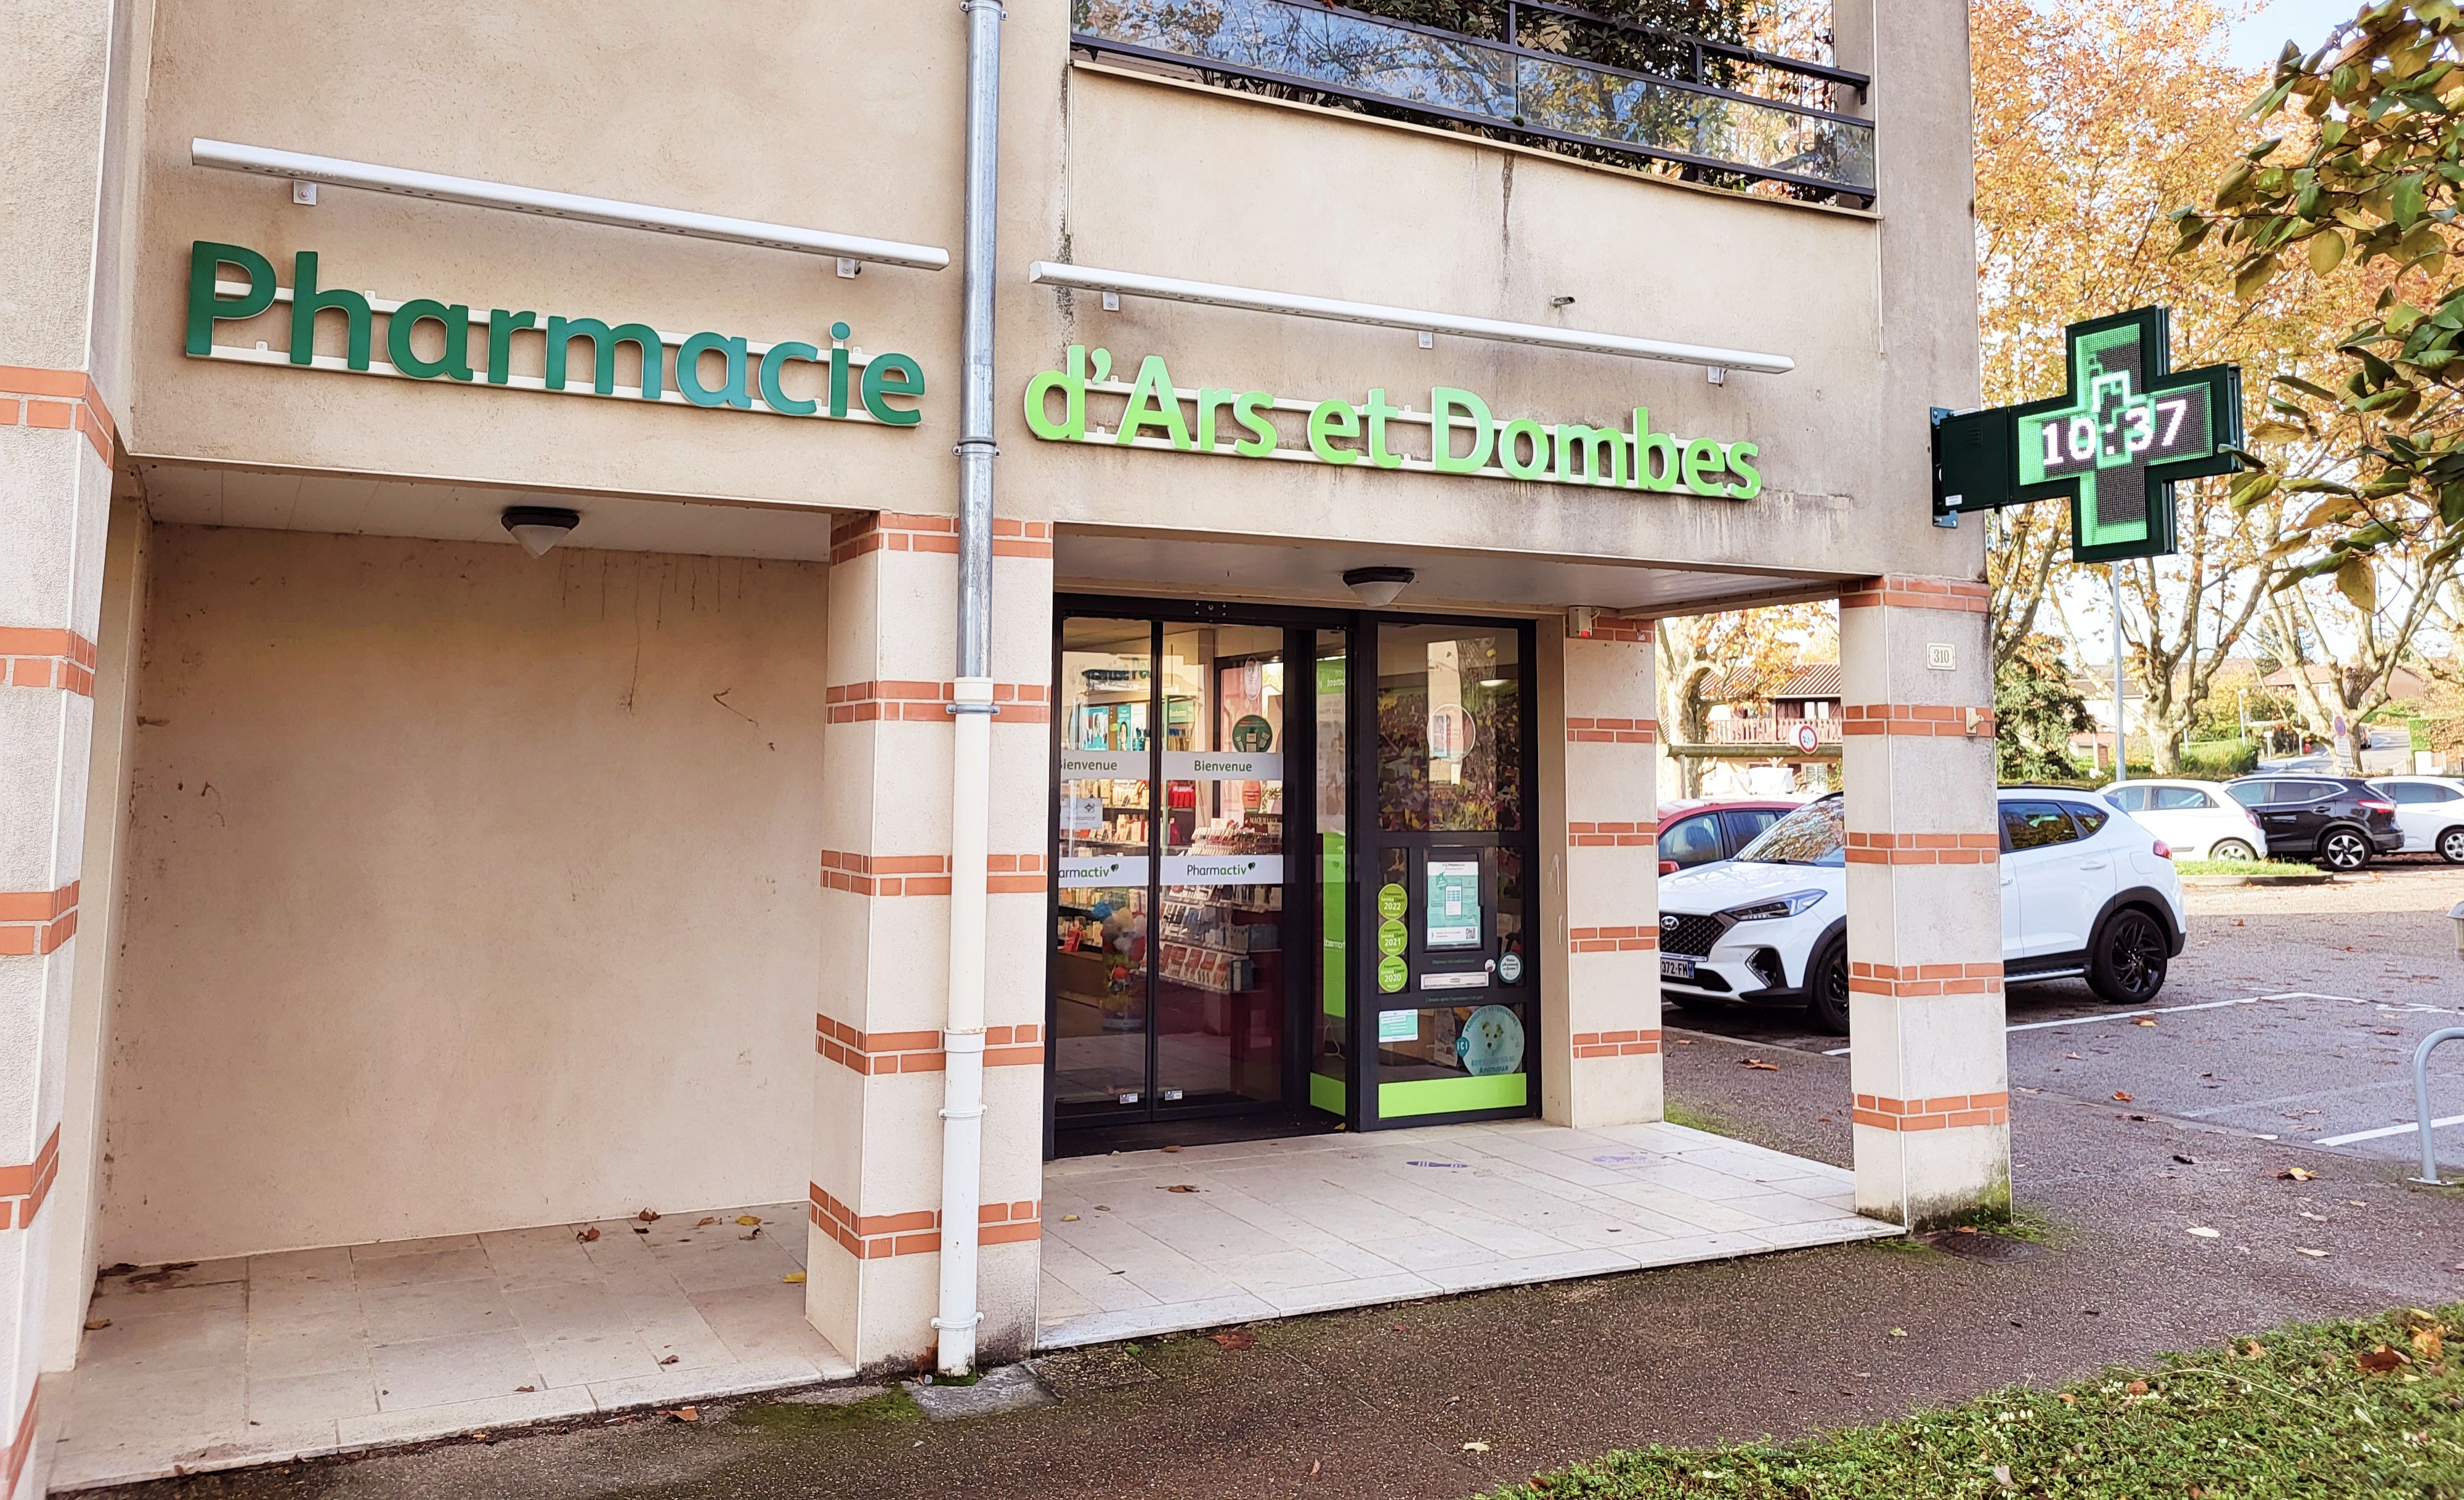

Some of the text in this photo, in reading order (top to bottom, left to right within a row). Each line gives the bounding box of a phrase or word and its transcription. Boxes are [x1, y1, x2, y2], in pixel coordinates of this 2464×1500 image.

[186, 240, 926, 427] Pharmacie
[2041, 399, 2187, 466] 10:37
[1307, 387, 1401, 469] et
[1430, 386, 1762, 500] Dombes
[1934, 649, 1950, 663] 310
[1060, 759, 1117, 771] ienvenue
[1194, 760, 1252, 772] Bienvenue
[1186, 864, 1247, 876] Pharmactiv
[1384, 902, 1401, 910] 2022
[1384, 938, 1401, 947] 2021
[1384, 974, 1401, 983] 2020
[1457, 1041, 1468, 1051] ICI
